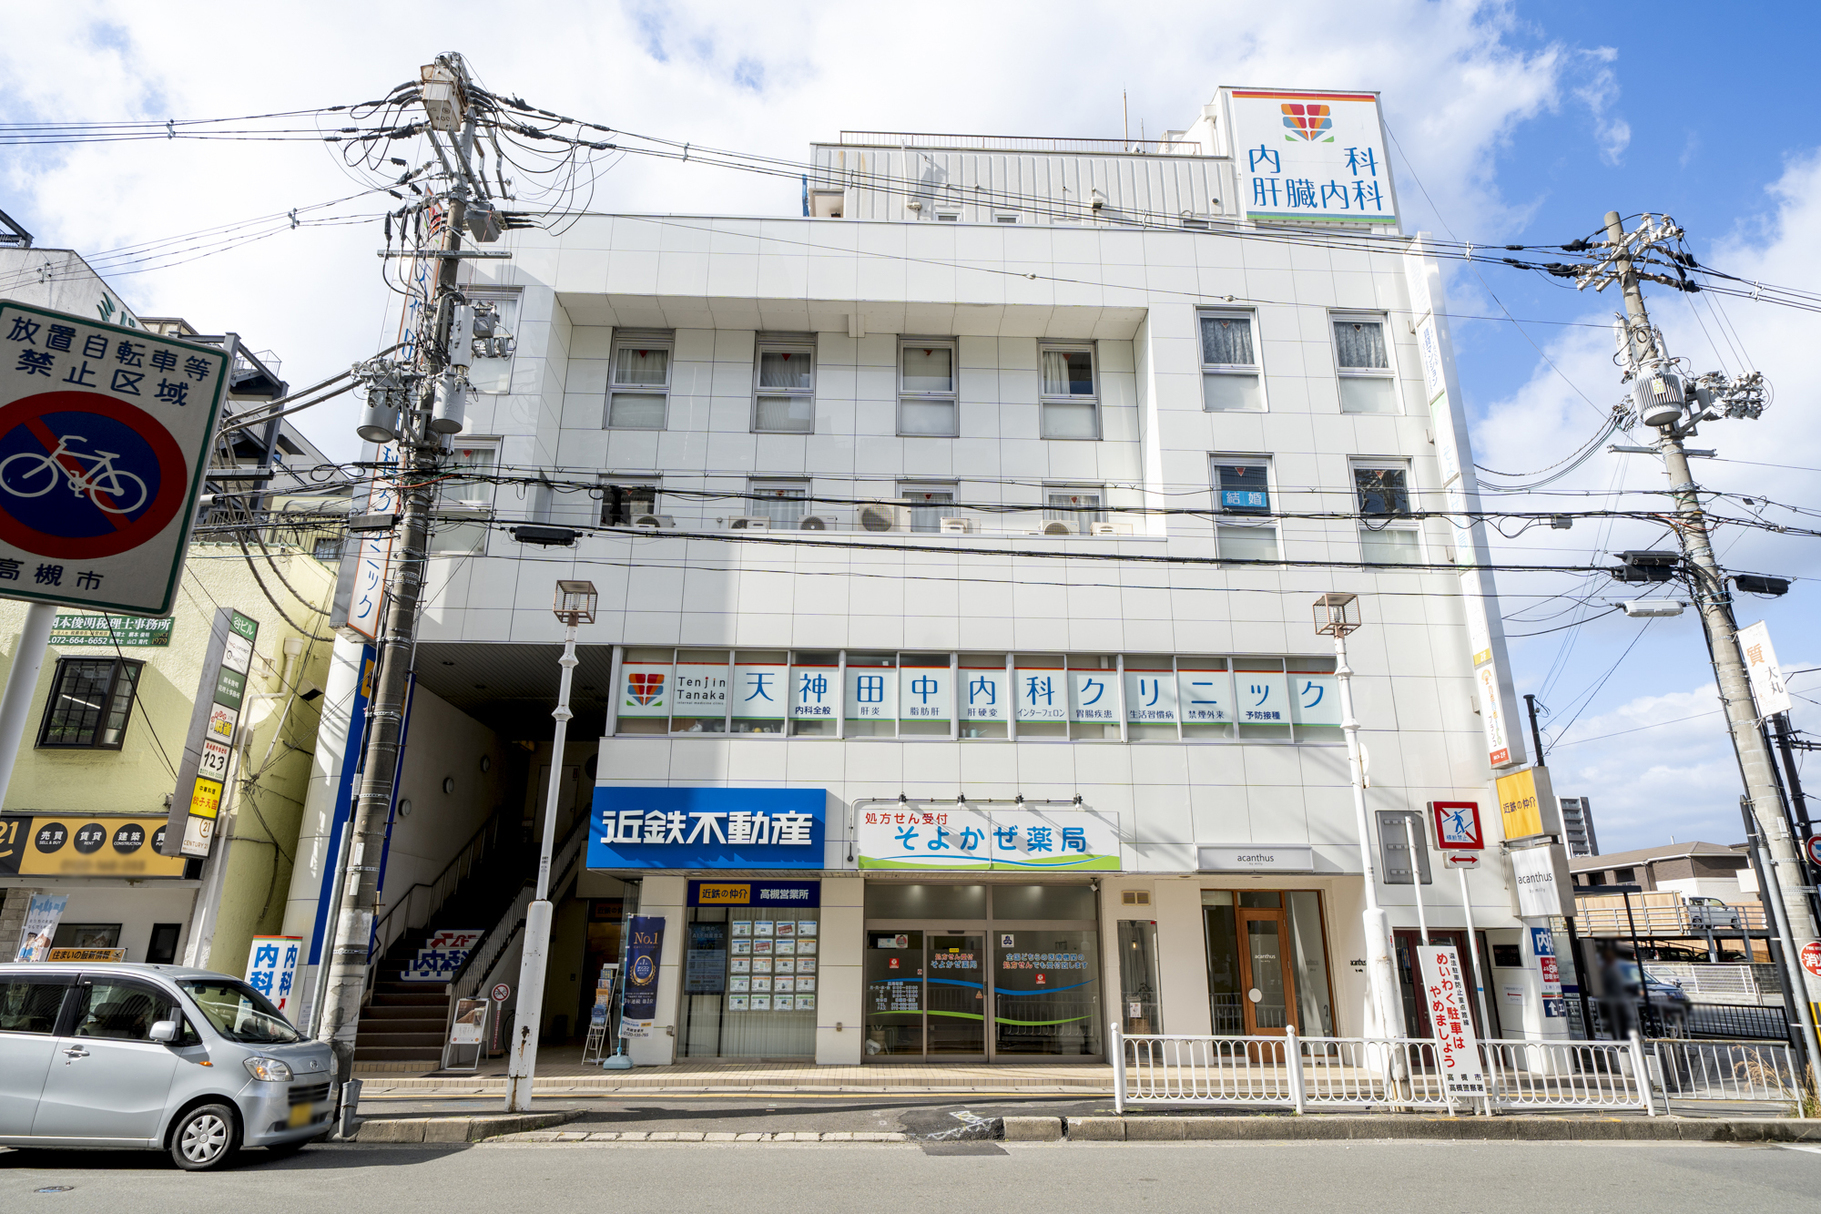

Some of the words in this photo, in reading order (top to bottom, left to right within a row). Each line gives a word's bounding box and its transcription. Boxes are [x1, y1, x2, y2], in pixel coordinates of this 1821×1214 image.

[1248, 144, 1379, 177] 内科
[1252, 176, 1383, 211] 肝臓内科
[6, 315, 212, 382] 放置自転車等
[15, 348, 190, 407] 禁止区域
[1226, 491, 1262, 505] 結婚
[0, 557, 104, 591] 高槻市
[233, 616, 254, 635] 谷ビル
[1746, 643, 1765, 667] 質
[678, 676, 726, 689] Tenjin
[677, 689, 725, 700] Tanaka
[794, 705, 831, 716] 内科全般
[860, 706, 881, 716] 肝炎
[909, 706, 940, 717] 脂肪肝
[967, 707, 998, 717] 肝硬変
[1017, 708, 1065, 717] インターフェロン
[1075, 709, 1113, 719] 胃腸疾患
[1129, 709, 1175, 720] 生活習慣病
[1188, 709, 1225, 720] 禁煙外来
[1245, 710, 1281, 721] 予防接種
[213, 718, 233, 737] 麻雀
[204, 751, 225, 772] 123
[1503, 796, 1536, 814] 近鉄の仲介
[865, 812, 949, 825] 処方せん受付
[600, 809, 813, 845] 近鉄不動産
[40, 831, 64, 841] 売買
[79, 831, 103, 841] 賃貸
[118, 831, 141, 841] 建築
[894, 824, 1087, 852] そよかぜ薬局
[183, 839, 204, 849] CENTURY
[1236, 853, 1275, 862] acanthus
[1518, 871, 1553, 884] acanthus
[701, 888, 748, 899] 近鉄の仲介
[760, 888, 810, 900] 高槻営業所
[449, 934, 477, 947] 2F
[633, 931, 658, 945] No.1
[52, 950, 111, 960] 住まいの最新情報
[935, 953, 974, 961] 処方せん受付
[279, 944, 298, 996] 内科
[930, 960, 978, 969] そよかぜ薬局
[1448, 952, 1470, 1026] 違法駐車防止重点路線
[1436, 952, 1466, 1049] めいわく駐車は
[1429, 985, 1456, 1068] やめましょう
[1449, 1084, 1484, 1092] 高槻警察署
